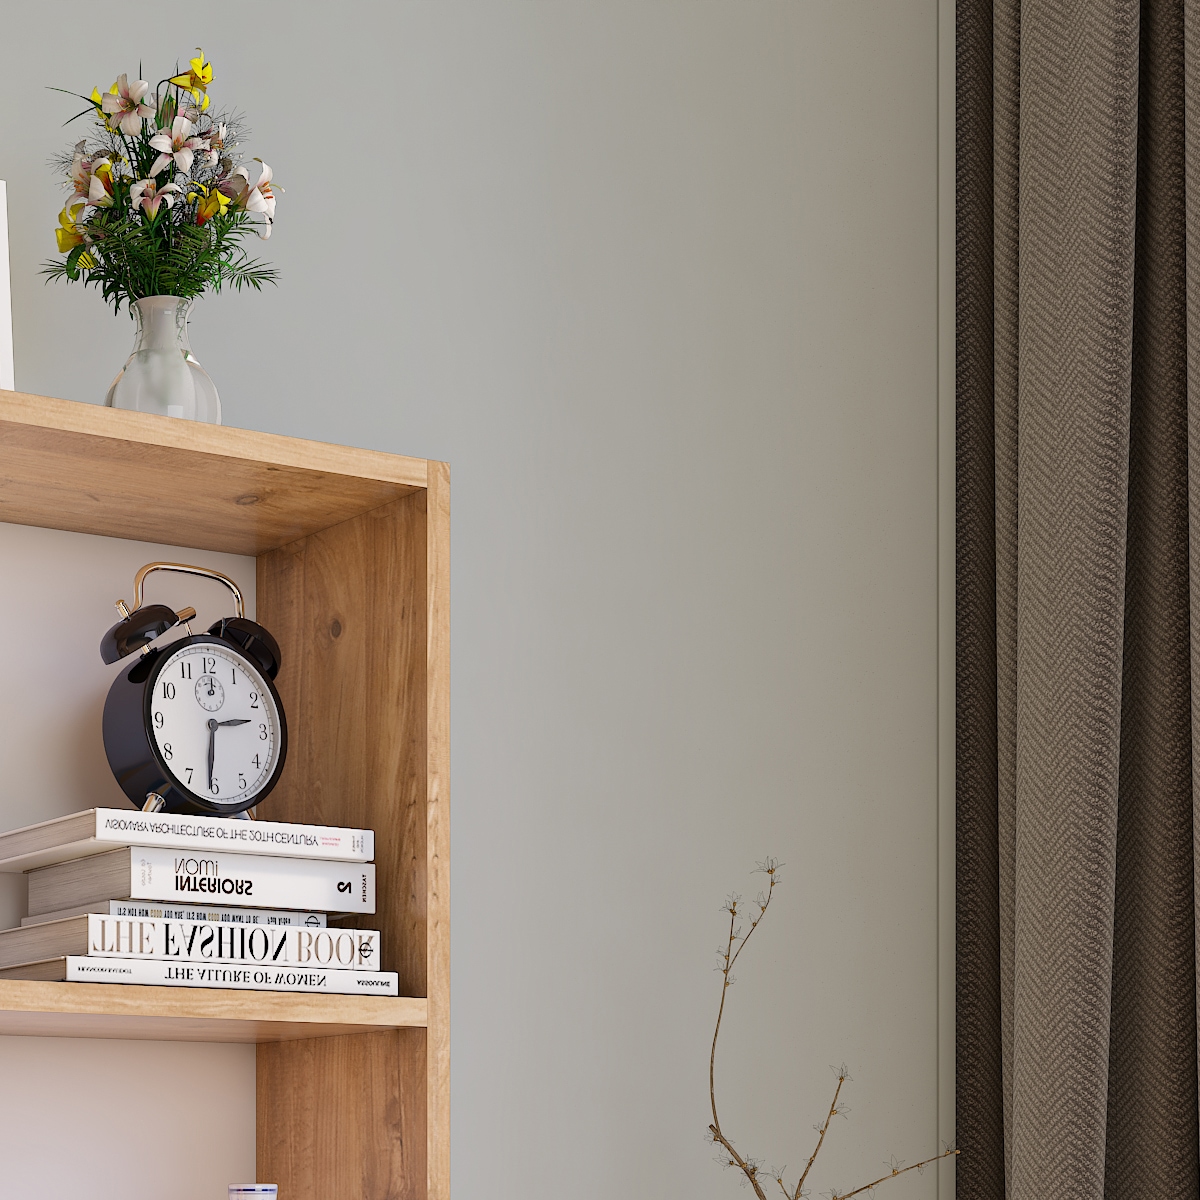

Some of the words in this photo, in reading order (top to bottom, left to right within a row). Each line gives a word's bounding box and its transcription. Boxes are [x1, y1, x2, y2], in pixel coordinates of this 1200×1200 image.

[180, 661, 192, 680] 11
[202, 657, 216, 674] 12
[231, 668, 237, 685] 1
[162, 682, 176, 700] 10
[250, 692, 258, 709] 2
[155, 711, 164, 729] 9
[259, 723, 268, 740] 3
[163, 743, 173, 760] 8
[251, 753, 261, 769] 4
[185, 767, 194, 784] 7
[238, 773, 247, 789] 5
[211, 778, 219, 795] 6
